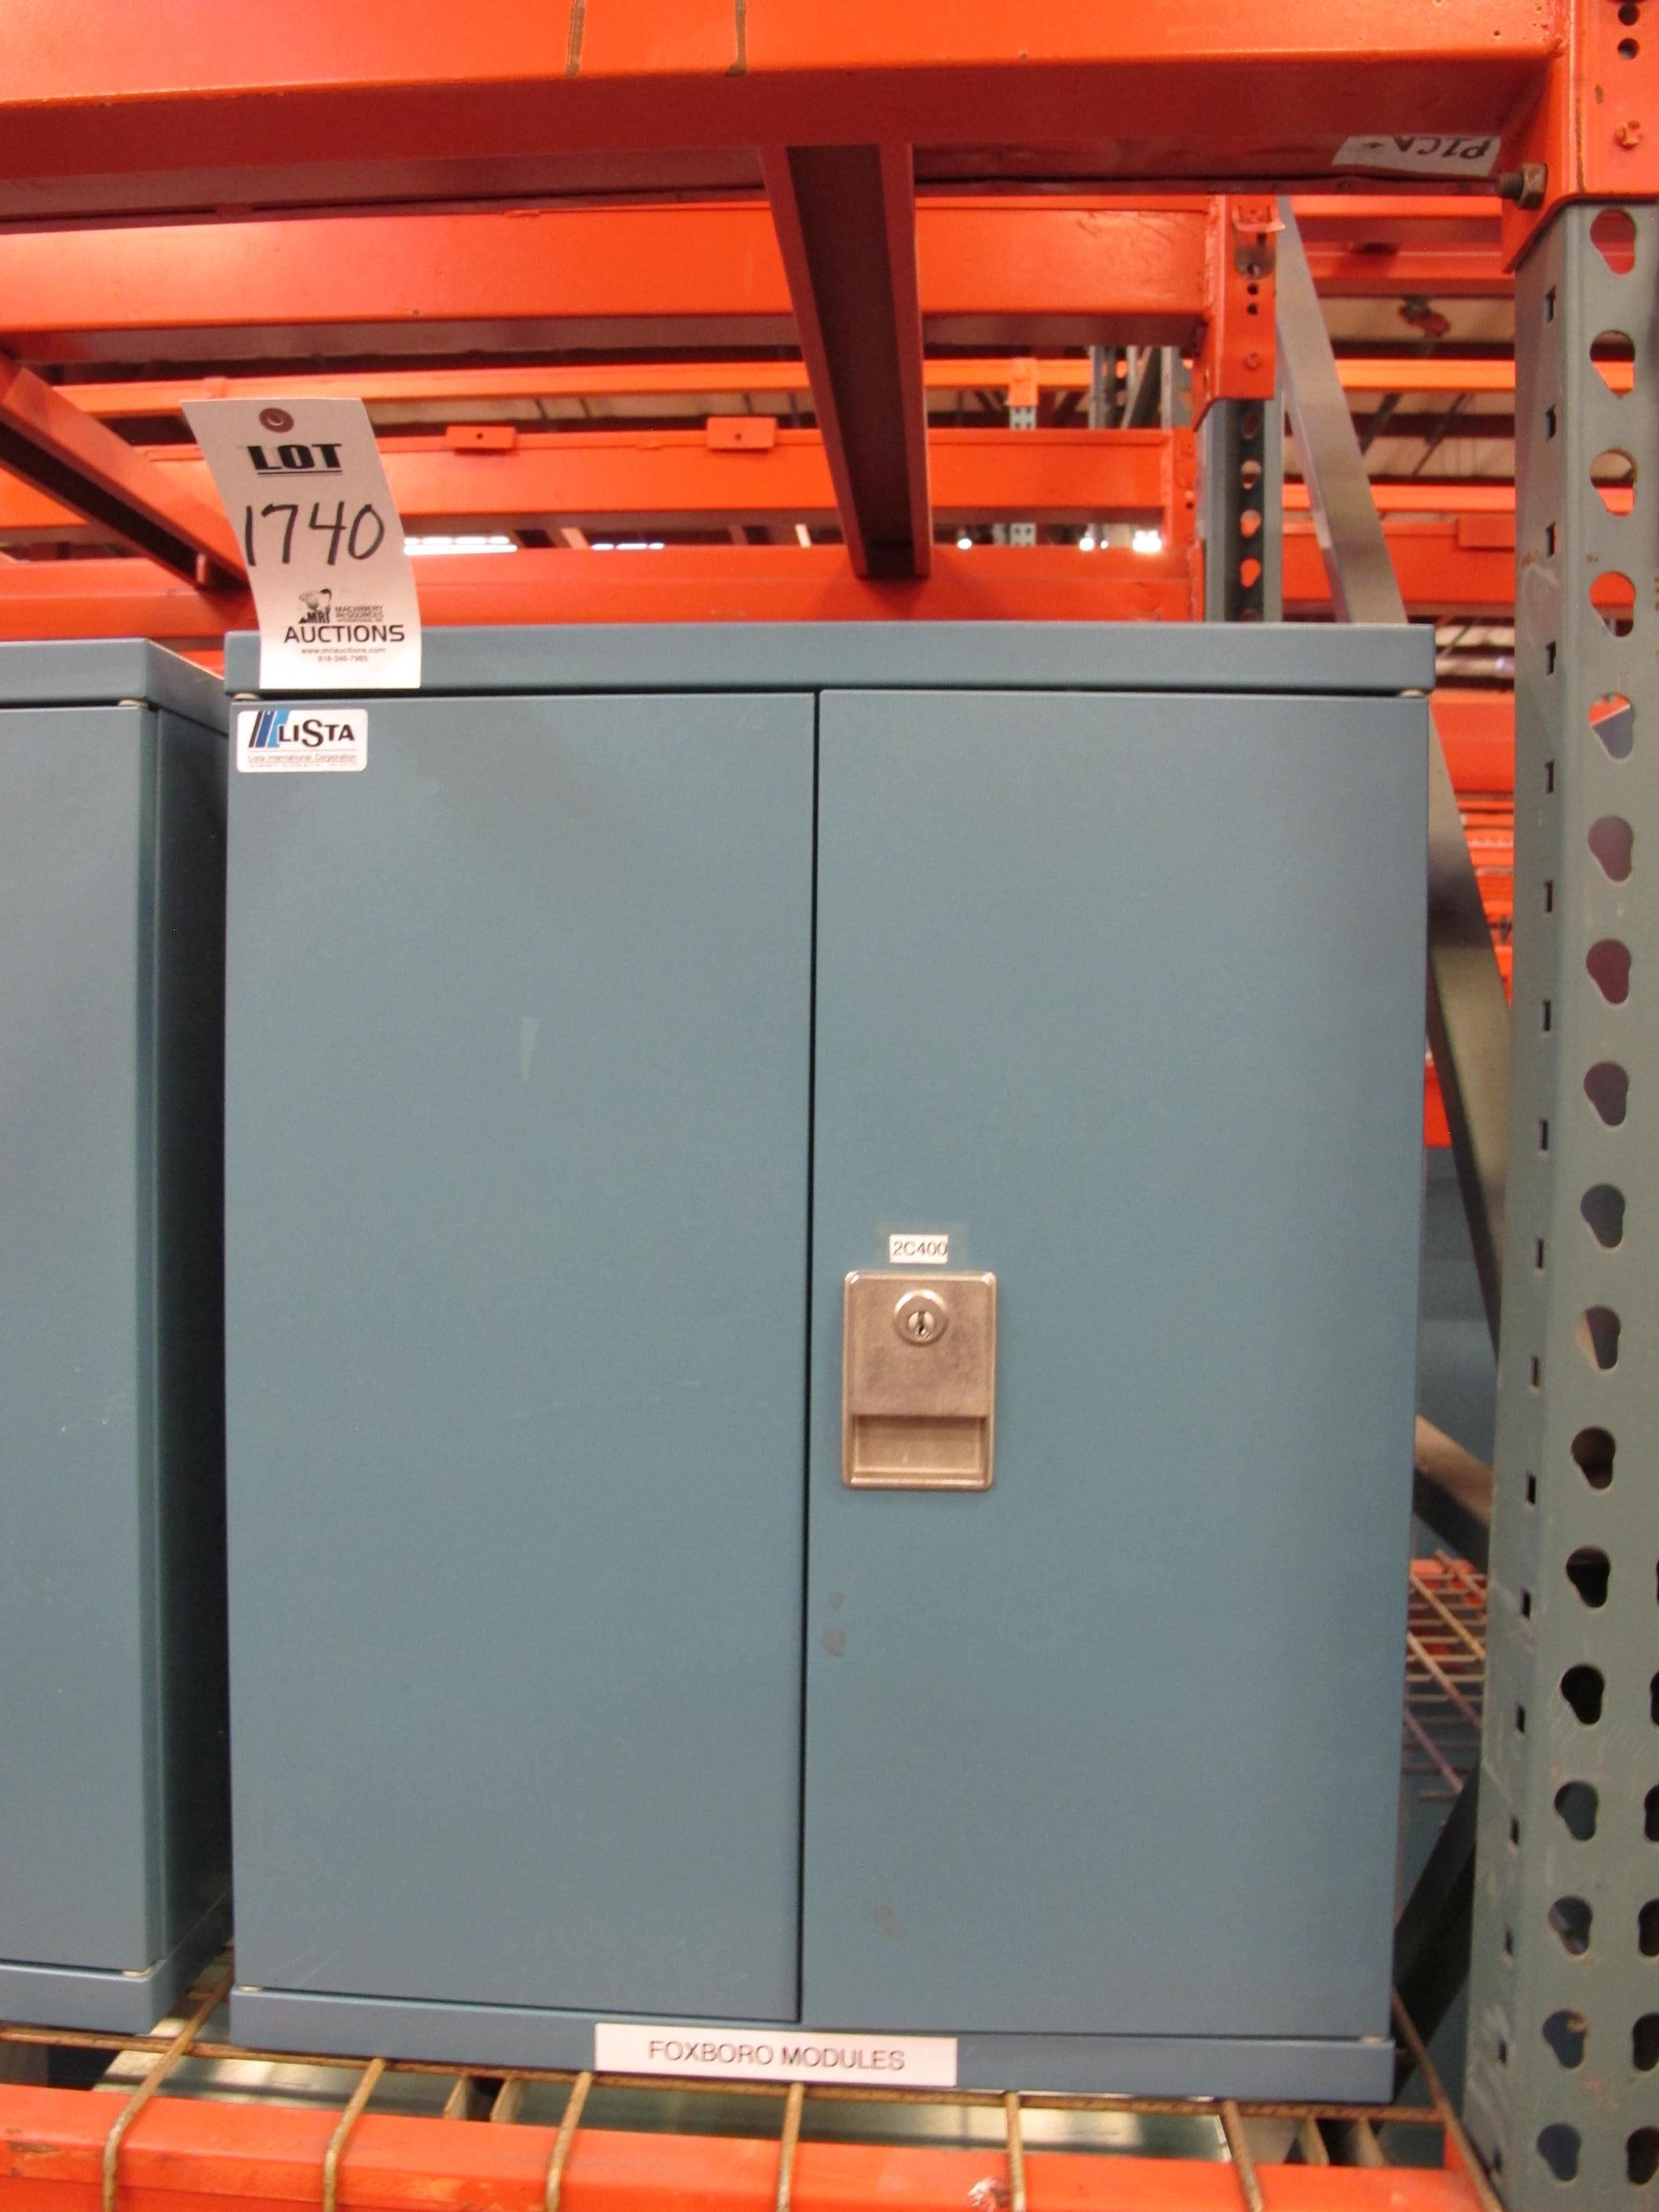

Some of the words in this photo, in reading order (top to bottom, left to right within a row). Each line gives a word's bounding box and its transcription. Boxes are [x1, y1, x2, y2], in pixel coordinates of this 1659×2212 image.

[247, 443, 342, 471] LOT
[244, 500, 385, 567] 1740
[284, 624, 405, 643] AUCTIONS
[893, 1241, 947, 1256] 2C400
[648, 2040, 774, 2065] FOXBORO
[781, 2045, 905, 2071] MODULES
